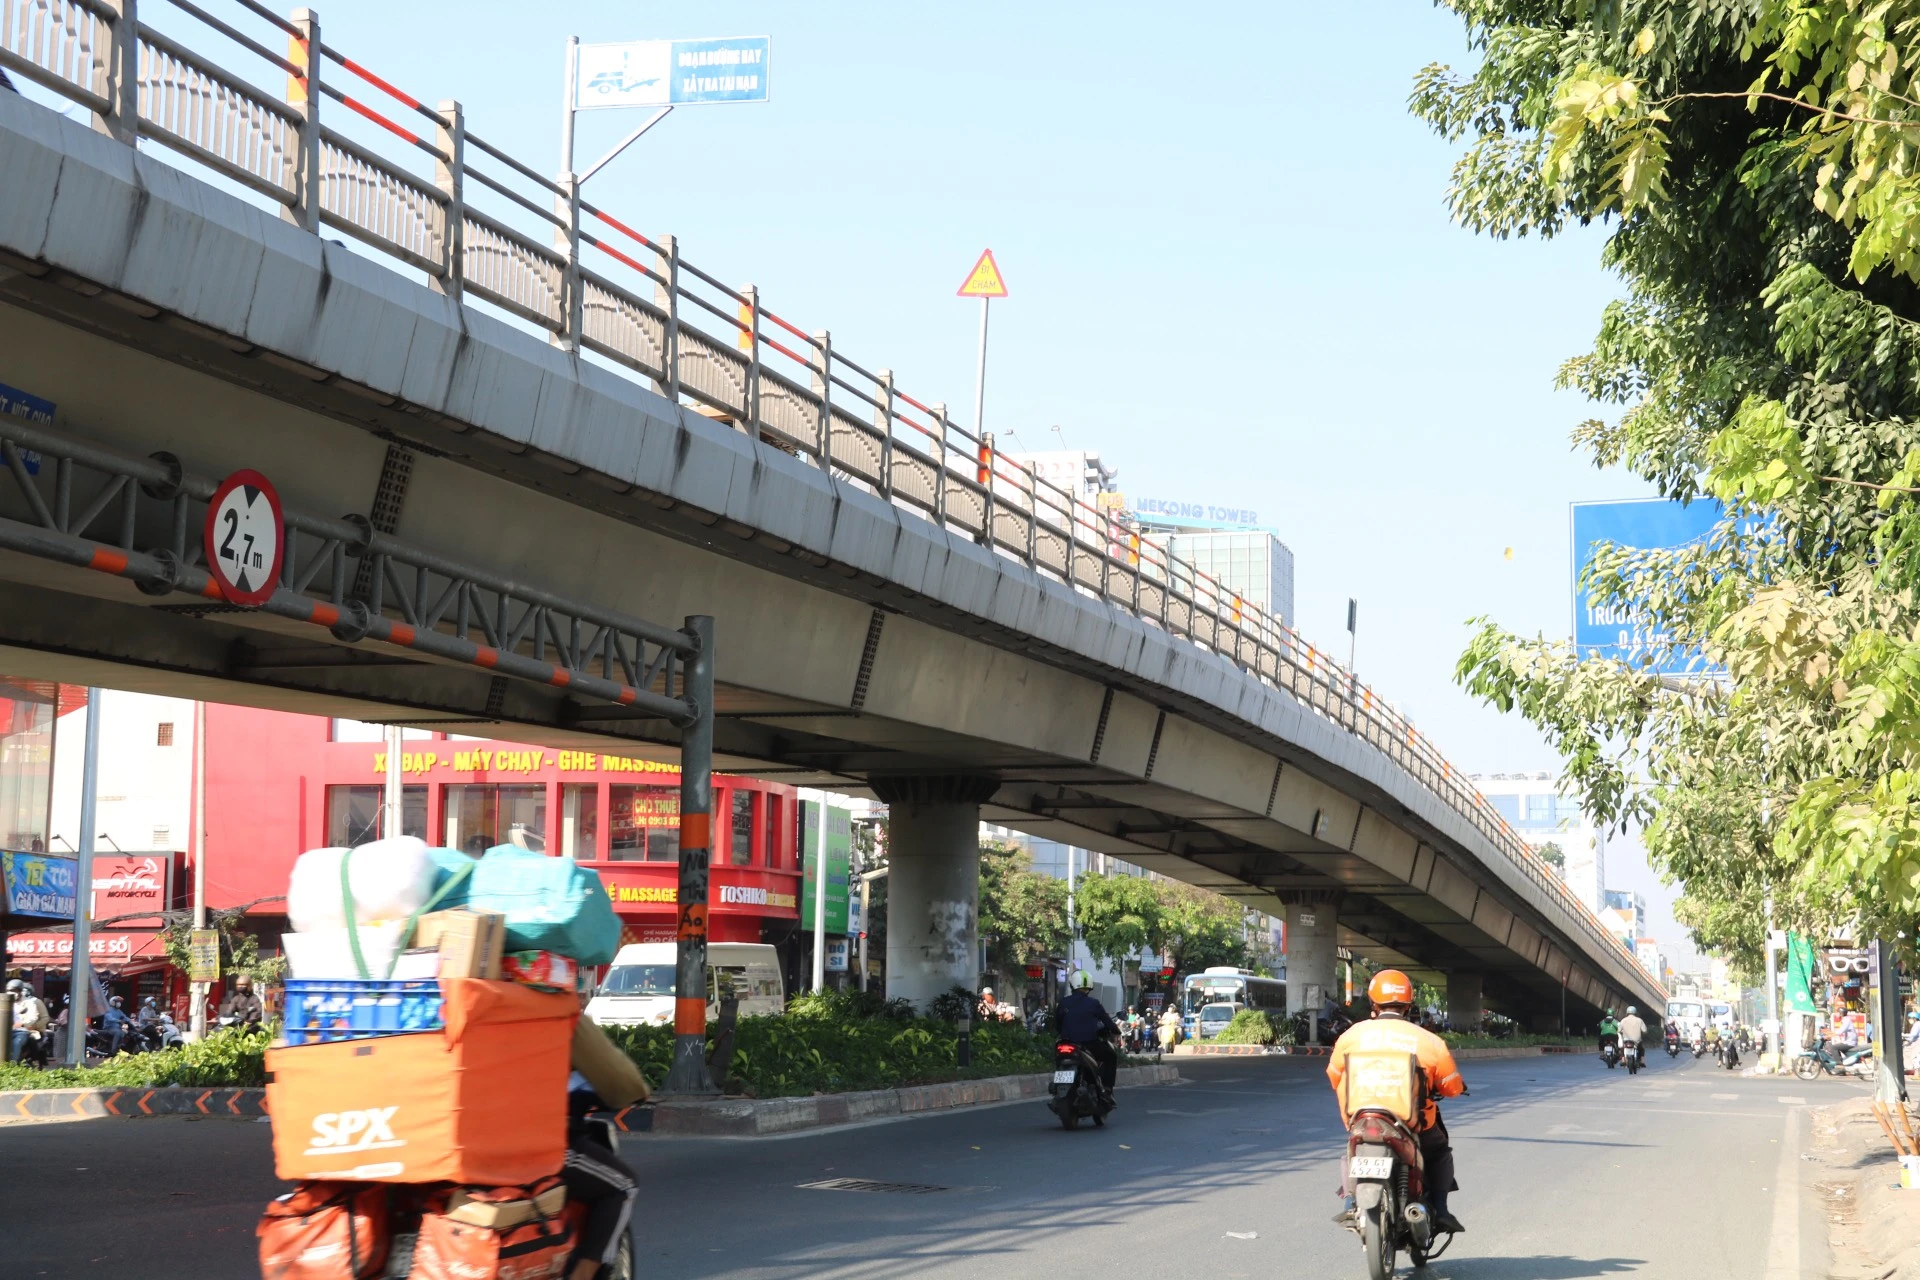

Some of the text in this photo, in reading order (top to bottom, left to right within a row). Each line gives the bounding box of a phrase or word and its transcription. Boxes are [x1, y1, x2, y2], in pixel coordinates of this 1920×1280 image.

[1137, 498, 1258, 524] MEKONG TOWER
[403, 752, 437, 776] ĐẠP
[454, 748, 492, 772] MÁY
[496, 751, 544, 775] CHẠY
[654, 796, 677, 814] THUÊ
[25, 859, 73, 888] TẾT TCL
[41, 891, 56, 913] GIÁ
[57, 896, 76, 917] MẠN
[106, 890, 157, 898] MOTORCYCLE
[619, 887, 677, 902] MASSAGE
[720, 885, 767, 905] TOSHIKO
[37, 940, 55, 953] XE
[89, 940, 105, 953] XE
[108, 935, 129, 953] SỐ
[309, 1105, 400, 1148] SPX
